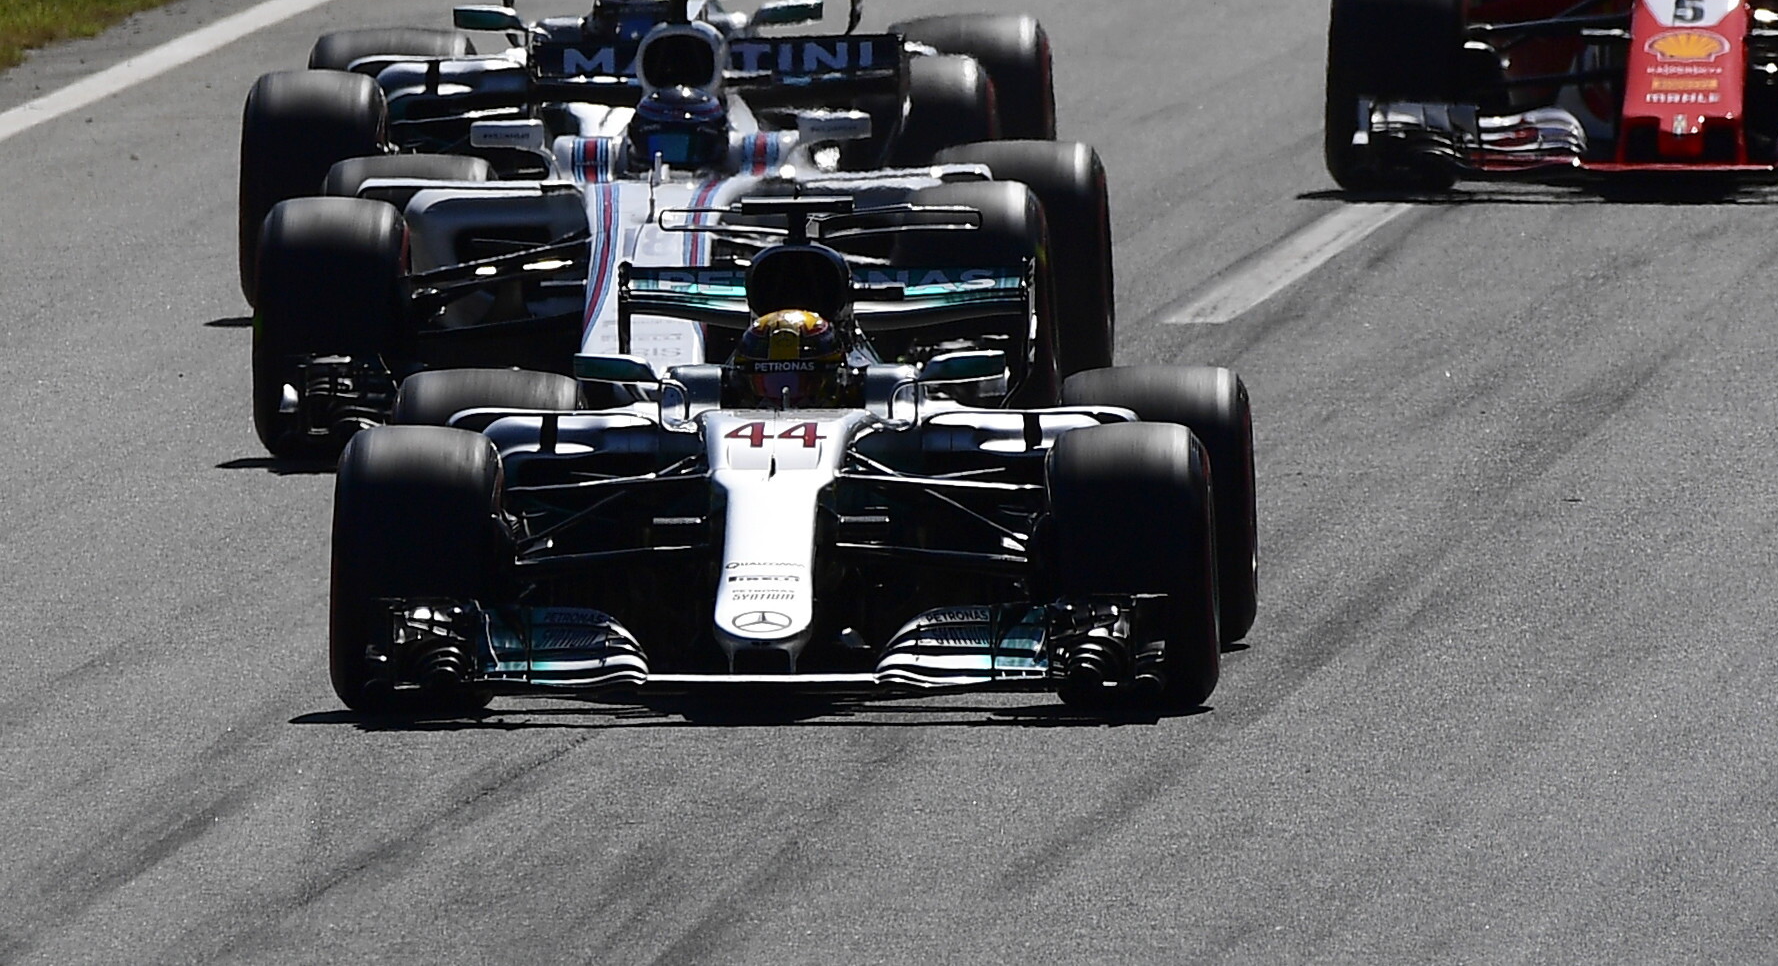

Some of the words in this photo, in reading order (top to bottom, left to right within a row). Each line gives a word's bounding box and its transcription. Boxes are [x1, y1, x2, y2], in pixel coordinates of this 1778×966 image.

[563, 42, 873, 74] MTINI
[754, 362, 815, 373] PETRONAS
[723, 421, 828, 448] 44
[926, 610, 990, 622] PETRONAS
